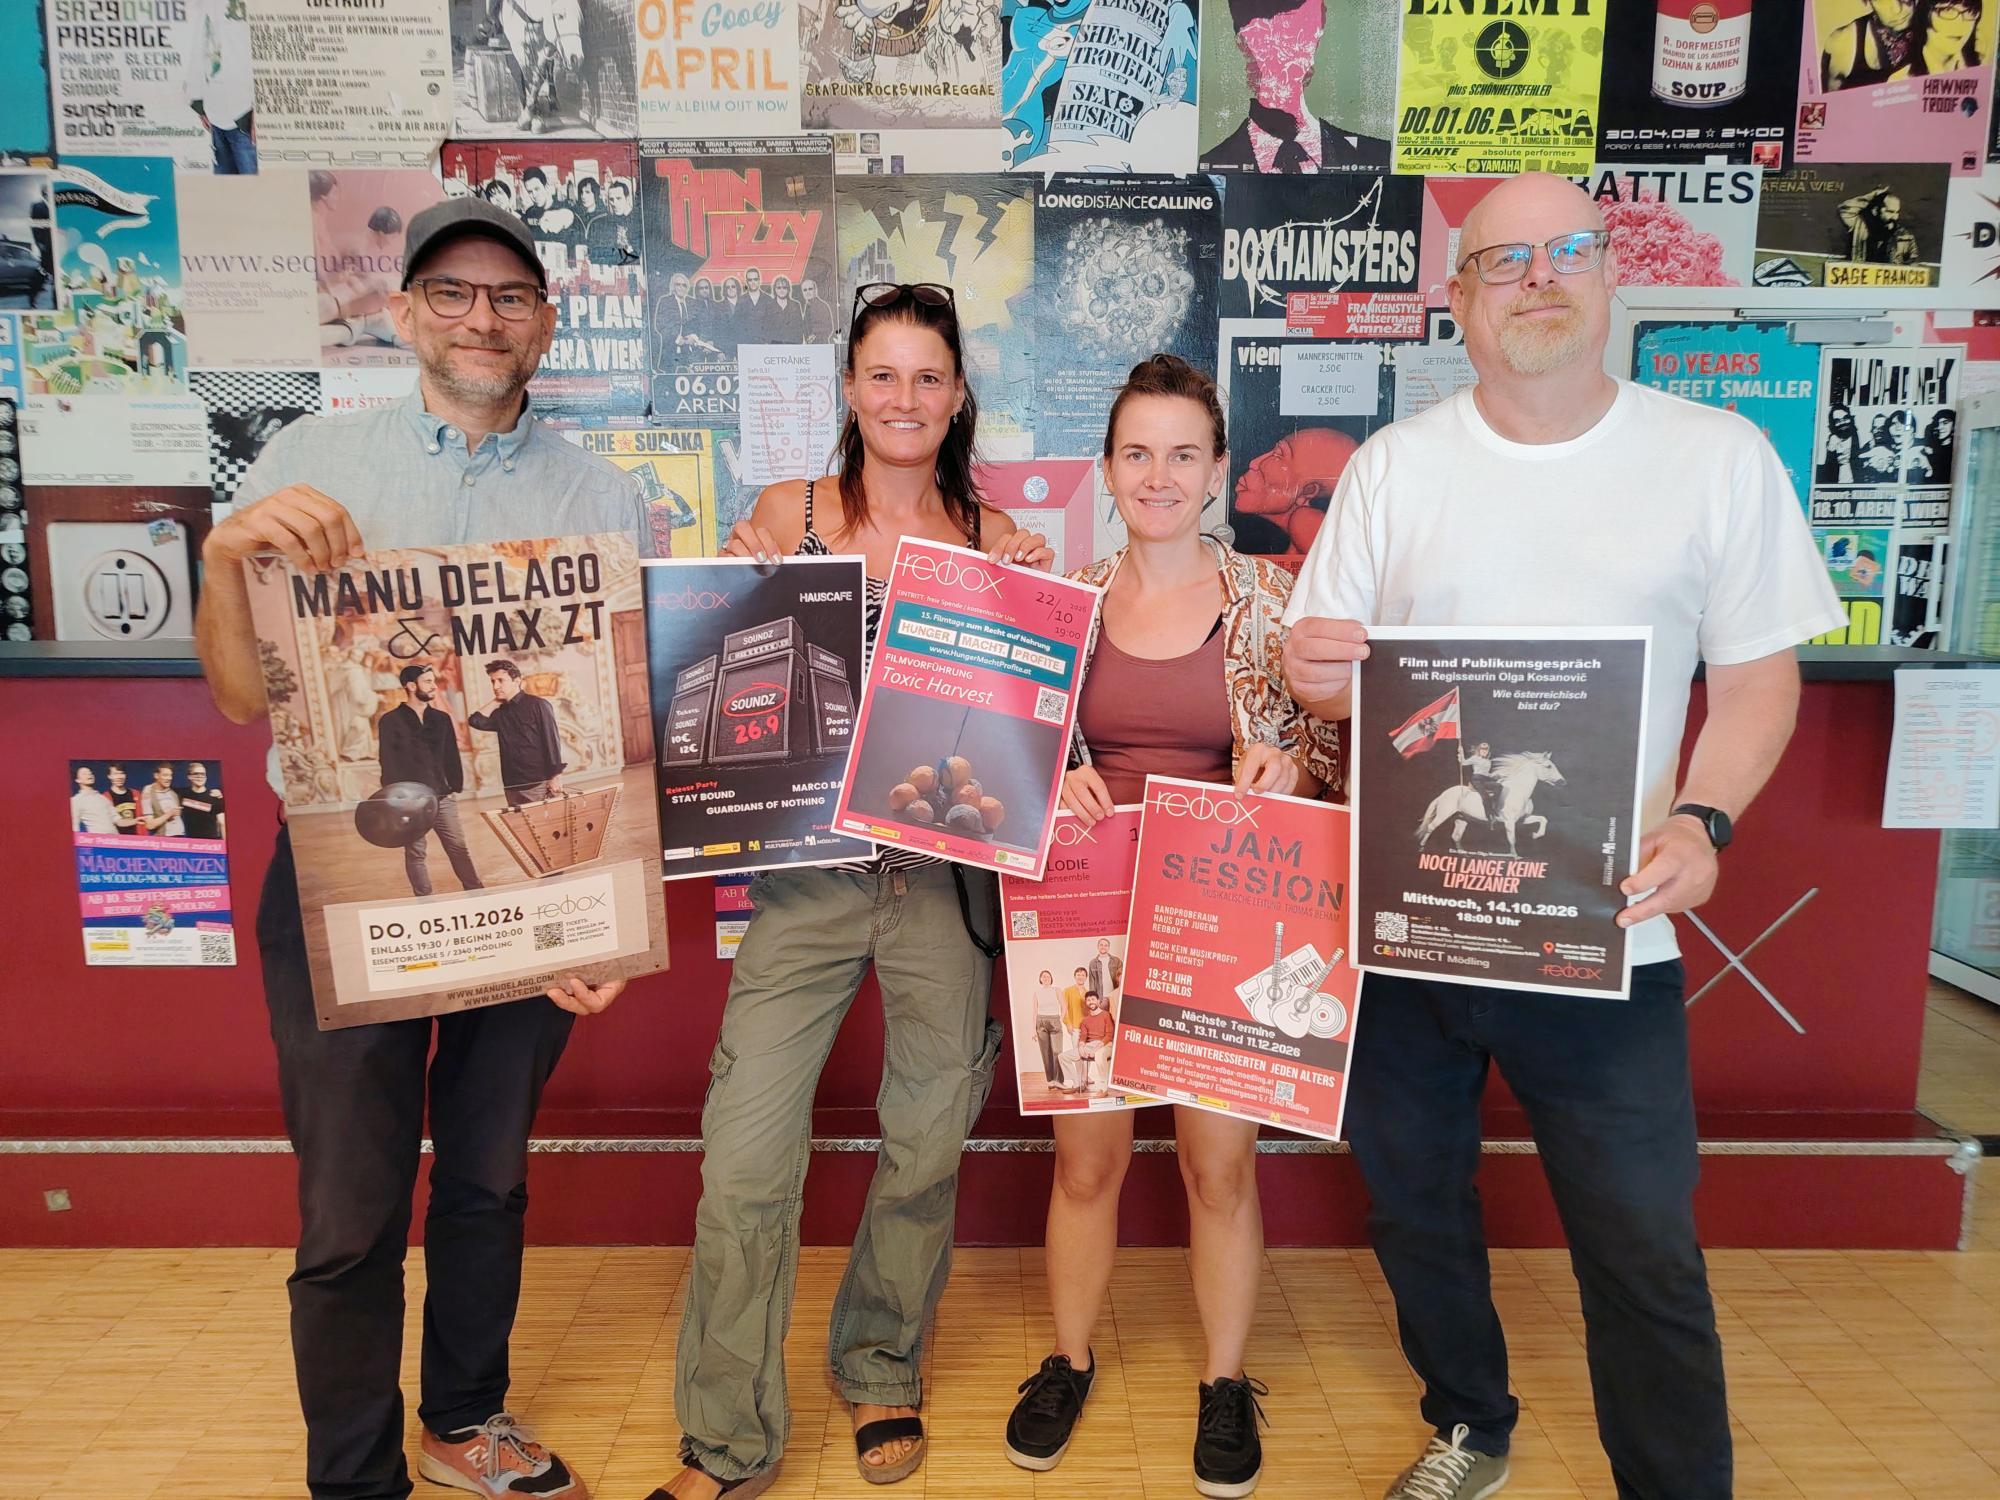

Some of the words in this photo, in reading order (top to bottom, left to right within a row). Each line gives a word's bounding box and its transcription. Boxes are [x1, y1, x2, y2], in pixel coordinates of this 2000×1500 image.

[638, 0, 693, 41] OF
[702, 0, 786, 38] Gooey
[57, 26, 173, 48] PASSAGE
[1676, 37, 1741, 50] DORFMEISTER
[640, 47, 789, 91] APRIL
[1073, 47, 1158, 93] TROUBLE
[1662, 58, 1693, 70] DZIHAN
[1696, 63, 1702, 71] &
[1705, 58, 1739, 71] KAMIEN
[1447, 84, 1466, 97] plus
[1469, 83, 1552, 97] SCHÖNHEITSFEHLER
[1671, 81, 1726, 98] SOUP
[63, 99, 145, 118] sunshine
[641, 101, 670, 112] NEW
[675, 100, 721, 112] ALBUM
[725, 100, 752, 112] OUT
[757, 100, 788, 112] NOW
[1399, 106, 1495, 135] DO.01.06.
[1495, 108, 1594, 137] ARENA
[1606, 129, 1700, 139] 30.04.02
[1721, 128, 1784, 138] 24:00
[1402, 148, 1459, 156] AVANTE
[1480, 160, 1520, 172] YAMAHA
[655, 158, 763, 259] THIN
[690, 210, 823, 285] LIZZY
[1223, 228, 1416, 284] BOXHAMSTERS
[1830, 267, 1869, 285] SAGE
[1875, 268, 1926, 285] FRANCIS
[569, 295, 642, 328] PLAN
[1348, 304, 1423, 314] FRANKENSTYLE
[1347, 314, 1422, 324] whatsername
[1346, 324, 1420, 334] AmneZist
[591, 339, 643, 371] WIEN
[764, 355, 811, 365] GETRÄNKE
[1653, 354, 1678, 374] 10
[1684, 353, 1760, 375] YEARS
[1320, 364, 1342, 372] 2,50€
[1301, 385, 1333, 394] CRACKER
[1720, 380, 1812, 398] SMALLER
[676, 398, 740, 413] AREN
[582, 433, 616, 452] CHE
[292, 567, 423, 618] MANU
[438, 552, 601, 609] DELAGO
[799, 591, 852, 602] HAUSCAFE
[1035, 592, 1054, 606] 22
[1054, 610, 1073, 624] 10
[387, 616, 441, 660] &
[451, 606, 546, 657] MAX
[559, 600, 605, 645] ZT
[742, 629, 774, 646] SOUNDZ
[921, 611, 932, 619] 15.
[933, 614, 965, 627] Filmtage
[966, 621, 983, 631] zum
[984, 625, 1006, 637] Recht
[1007, 632, 1020, 640] auf
[1020, 635, 1051, 652] Nahrung
[1055, 626, 1081, 640] 19:00
[885, 652, 974, 680] FILMVORFÜHRUNG
[929, 645, 1032, 676] www.HungerMachtProfite.at
[1399, 657, 1428, 668] Film
[1432, 658, 1458, 668] und
[1462, 658, 1601, 670] Publikumsgespräch
[881, 666, 923, 690] Toxic
[926, 675, 994, 706] Harvest
[1412, 672, 1429, 681] mit
[1431, 672, 1496, 682] Regisseurin
[1499, 672, 1525, 683] Olga
[730, 693, 777, 712] SOUNDZ
[1492, 690, 1512, 699] Wie
[1514, 689, 1588, 700] österreichisch
[1518, 702, 1538, 711] bist
[1540, 702, 1560, 711] du?
[734, 715, 779, 744] 26.9
[826, 718, 851, 726] Doors:
[671, 733, 691, 743] 10€
[679, 743, 698, 754] 12€
[696, 780, 718, 790] Party
[792, 782, 828, 792] MARCO
[671, 793, 698, 804] STAY
[700, 790, 735, 801] BOUND
[706, 802, 763, 815] GUARDIANS
[766, 800, 779, 811] OF
[781, 797, 825, 808] NOTHING
[1210, 828, 1303, 868] JAM
[79, 855, 226, 873] MÄRCHENPRINZEN
[1047, 858, 1089, 872] LODIE
[1418, 853, 1458, 872] NOCH
[1460, 860, 1505, 876] LANGE
[1506, 861, 1548, 878] KEINE
[1162, 853, 1344, 911] SESSION
[1443, 872, 1520, 894] LIPIZZANER
[721, 889, 736, 898] AB
[1155, 904, 1218, 924] BANDPROBERAUM
[1402, 892, 1482, 912] Mittwoch,
[1486, 900, 1578, 918] 14.10.2026
[369, 923, 412, 941] DO,
[419, 906, 523, 935] 05.11.2026
[1153, 914, 1173, 925] HAUS
[1175, 917, 1190, 928] DER
[1191, 920, 1219, 933] JUGEND
[1456, 912, 1493, 926] 18:00
[1496, 914, 1521, 927] Uhr
[1152, 923, 1181, 936] REDBOX
[371, 944, 414, 955] EINLASS
[417, 940, 442, 951] 19:30
[454, 933, 492, 945] BEGINN
[495, 928, 523, 939] 20:00
[372, 952, 438, 966] EISENTORGASSE
[474, 940, 512, 953] MÖDLING
[1149, 950, 1174, 962] MACHT
[1175, 954, 1204, 967] NICHTS!
[1150, 940, 1169, 951] NOCH
[1171, 943, 1188, 955] KEIN
[1190, 946, 1238, 964] MUSIKPROFI?
[1447, 954, 1490, 968] Mödling
[1148, 967, 1173, 982] 19-21
[1175, 973, 1193, 985] UHR
[447, 974, 555, 1000] WWW.MANUDELAGO.COM
[463, 985, 542, 1007] WWW.MAXZT.COM
[1145, 980, 1193, 998] KOSTENLOS
[1182, 1010, 1227, 1029] Nächste
[1231, 1021, 1276, 1039] Termine
[1159, 1018, 1191, 1034] 09.10.,
[1222, 1032, 1244, 1045] und
[1247, 1037, 1301, 1058] 11.12.2026
[1125, 1030, 1142, 1046] FÜR
[1143, 1034, 1164, 1049] ALLE
[1166, 1039, 1267, 1071] MUSIKINTERESSIERTEN
[1270, 1063, 1299, 1080] JEDEN
[1300, 1070, 1335, 1088] ALTERS
[1113, 1077, 1157, 1093] HAUSCAFE
[1157, 1071, 1175, 1083] Haus
[1187, 1077, 1211, 1090] Jugend
